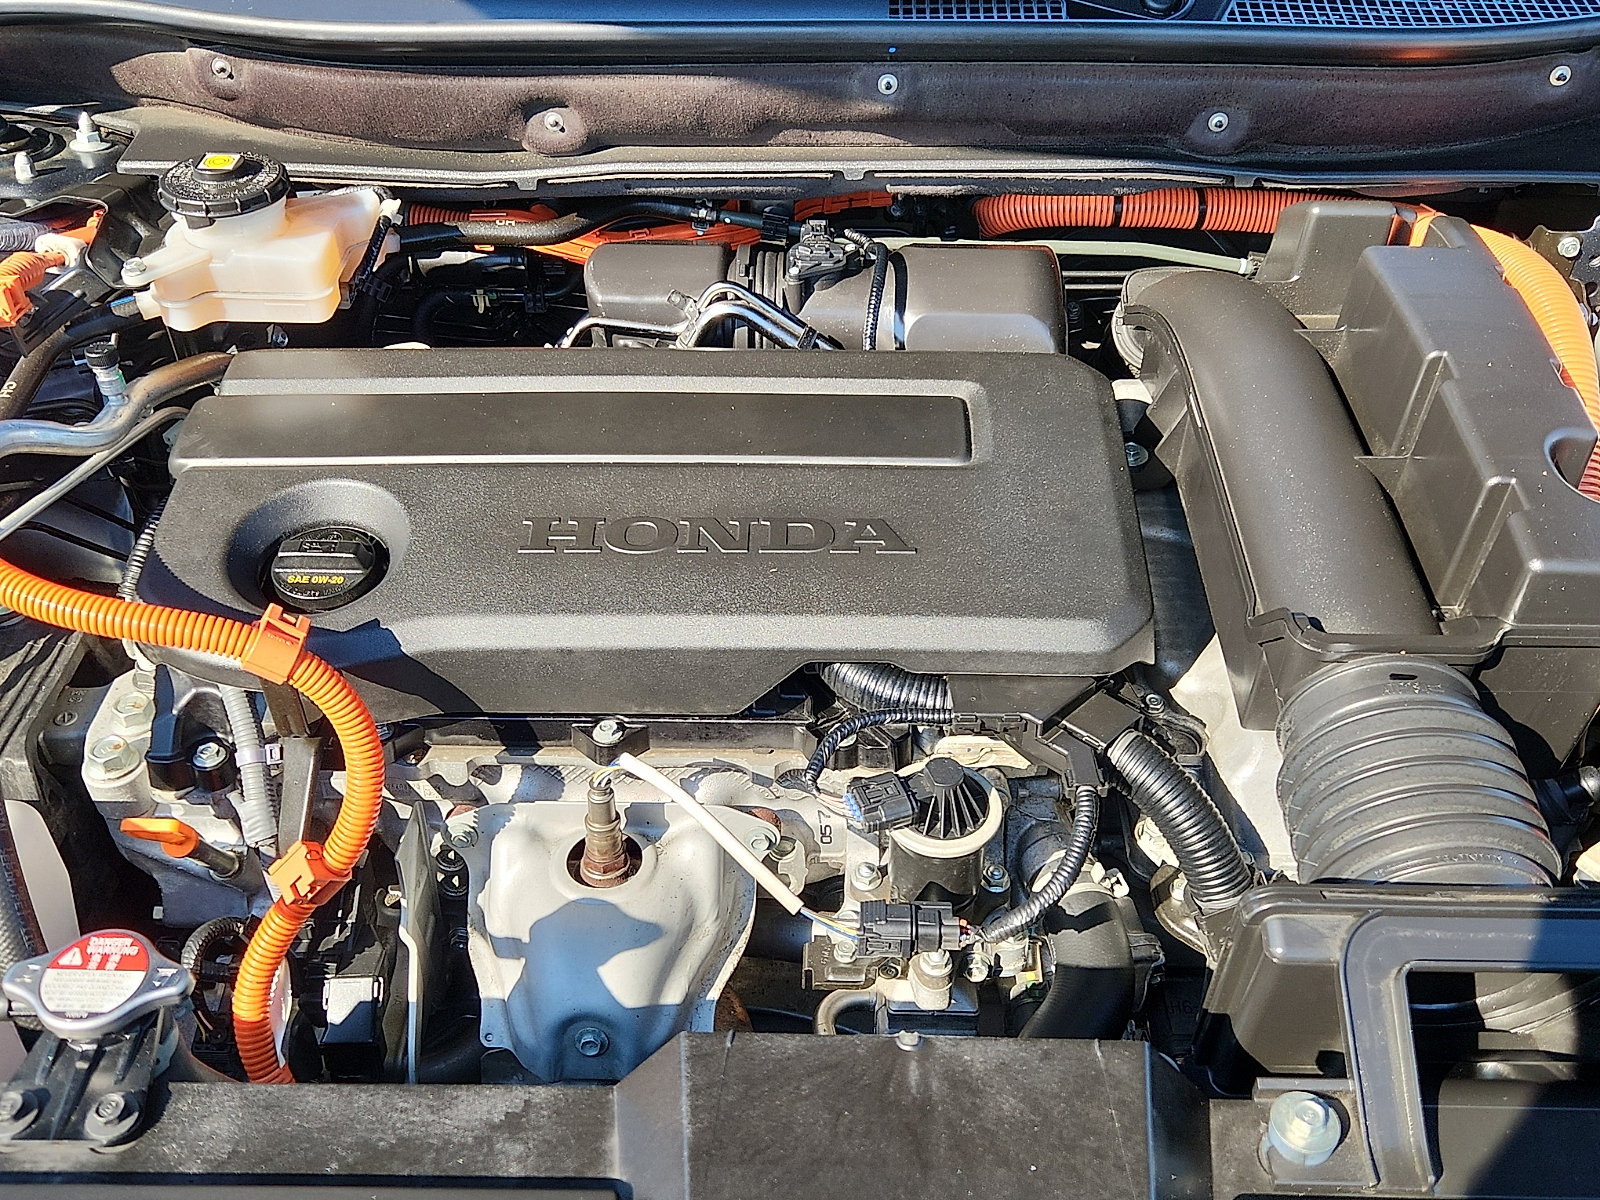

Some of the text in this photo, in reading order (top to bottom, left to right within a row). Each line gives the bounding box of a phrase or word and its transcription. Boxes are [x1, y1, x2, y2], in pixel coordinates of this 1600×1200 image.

[517, 516, 918, 554] HONDA
[287, 575, 310, 584] SAE
[818, 810, 832, 844] 057
